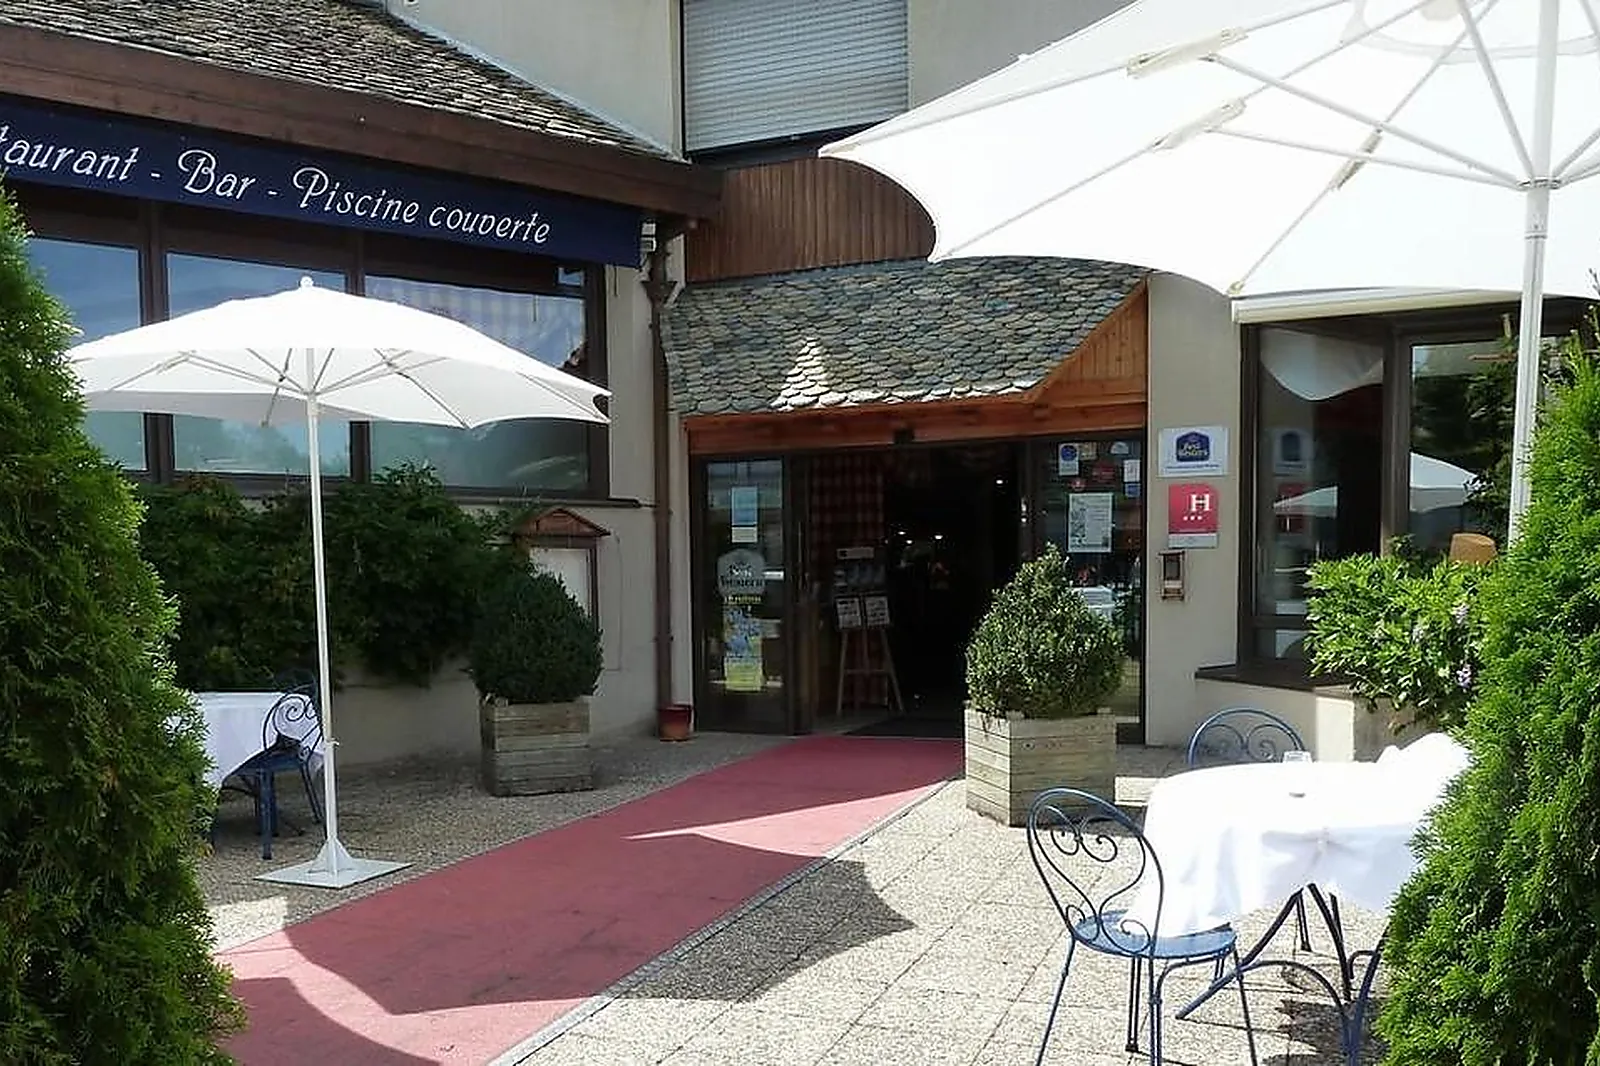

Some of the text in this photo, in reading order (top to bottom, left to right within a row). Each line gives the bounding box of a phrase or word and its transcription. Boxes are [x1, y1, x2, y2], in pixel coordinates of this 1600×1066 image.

[178, 150, 256, 200] Bar
[293, 168, 420, 223] Piscine
[428, 207, 551, 244] couverte
[1190, 493, 1211, 512] H
